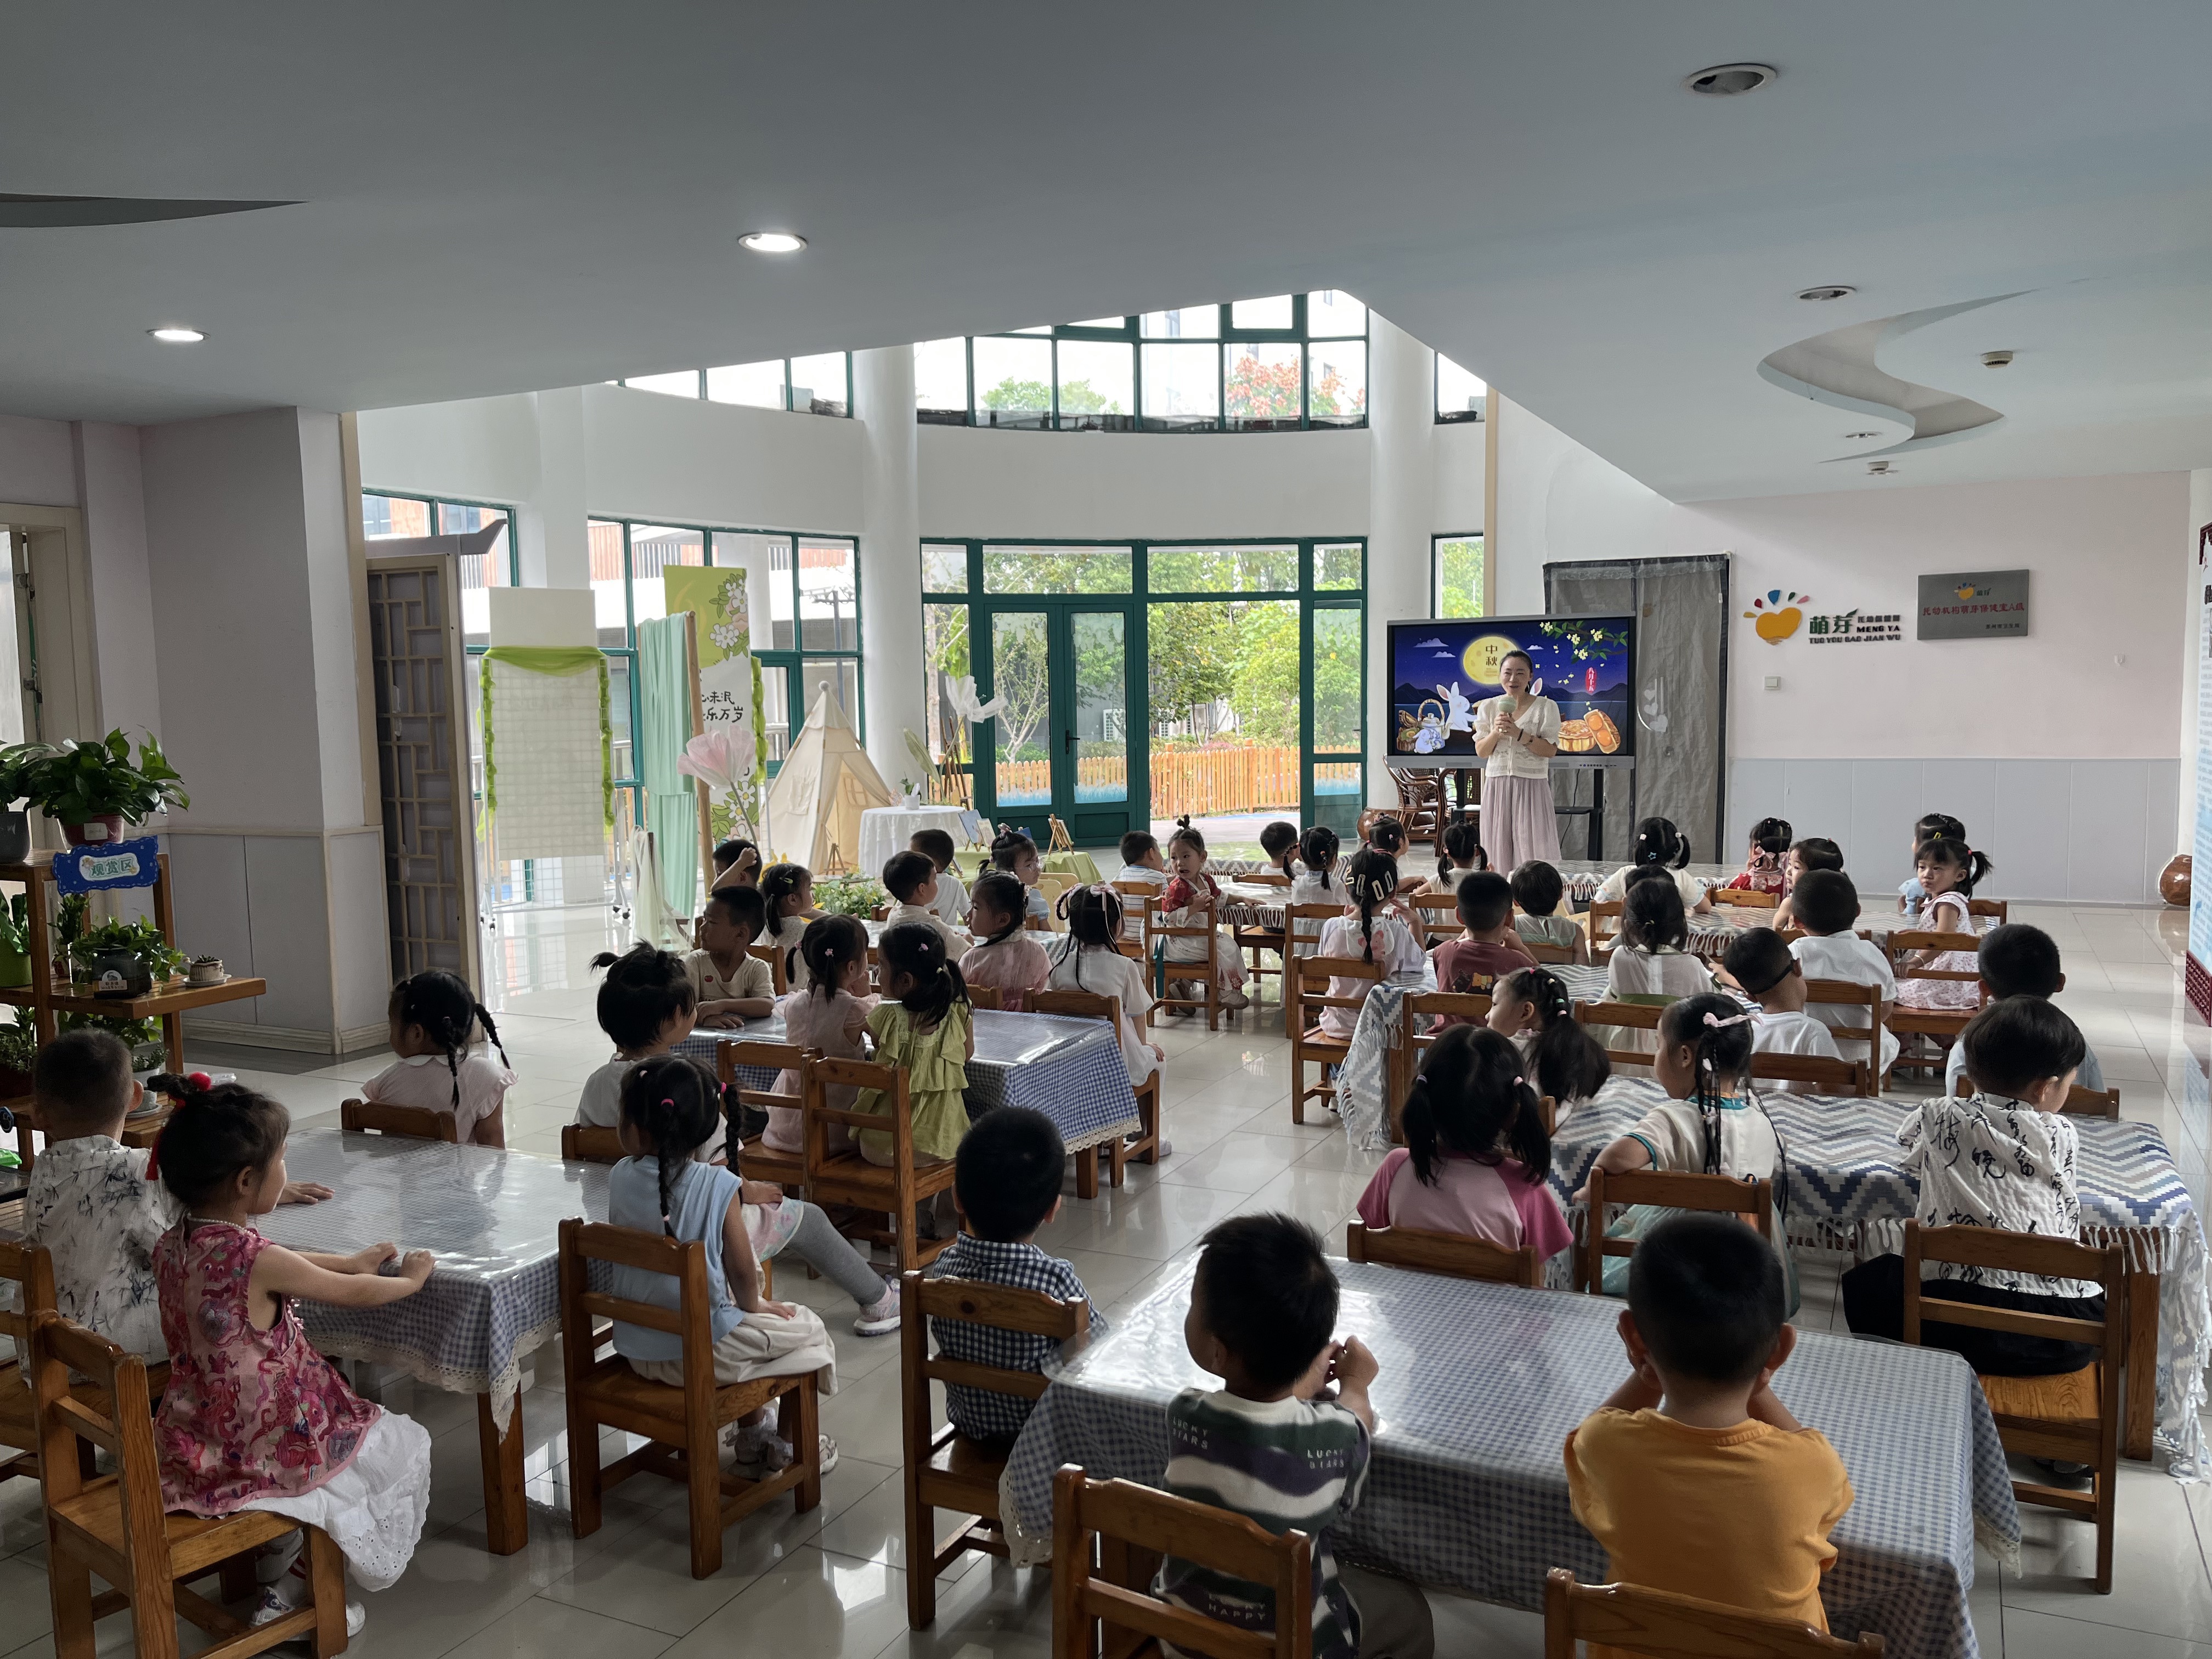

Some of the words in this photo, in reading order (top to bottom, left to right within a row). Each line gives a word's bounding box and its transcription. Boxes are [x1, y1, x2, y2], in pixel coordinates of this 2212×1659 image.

[1809, 608, 1858, 634] 萌芽
[1485, 644, 1498, 666] 中秋
[703, 706, 743, 723] 乐万岁
[91, 859, 132, 877] 观赏区
